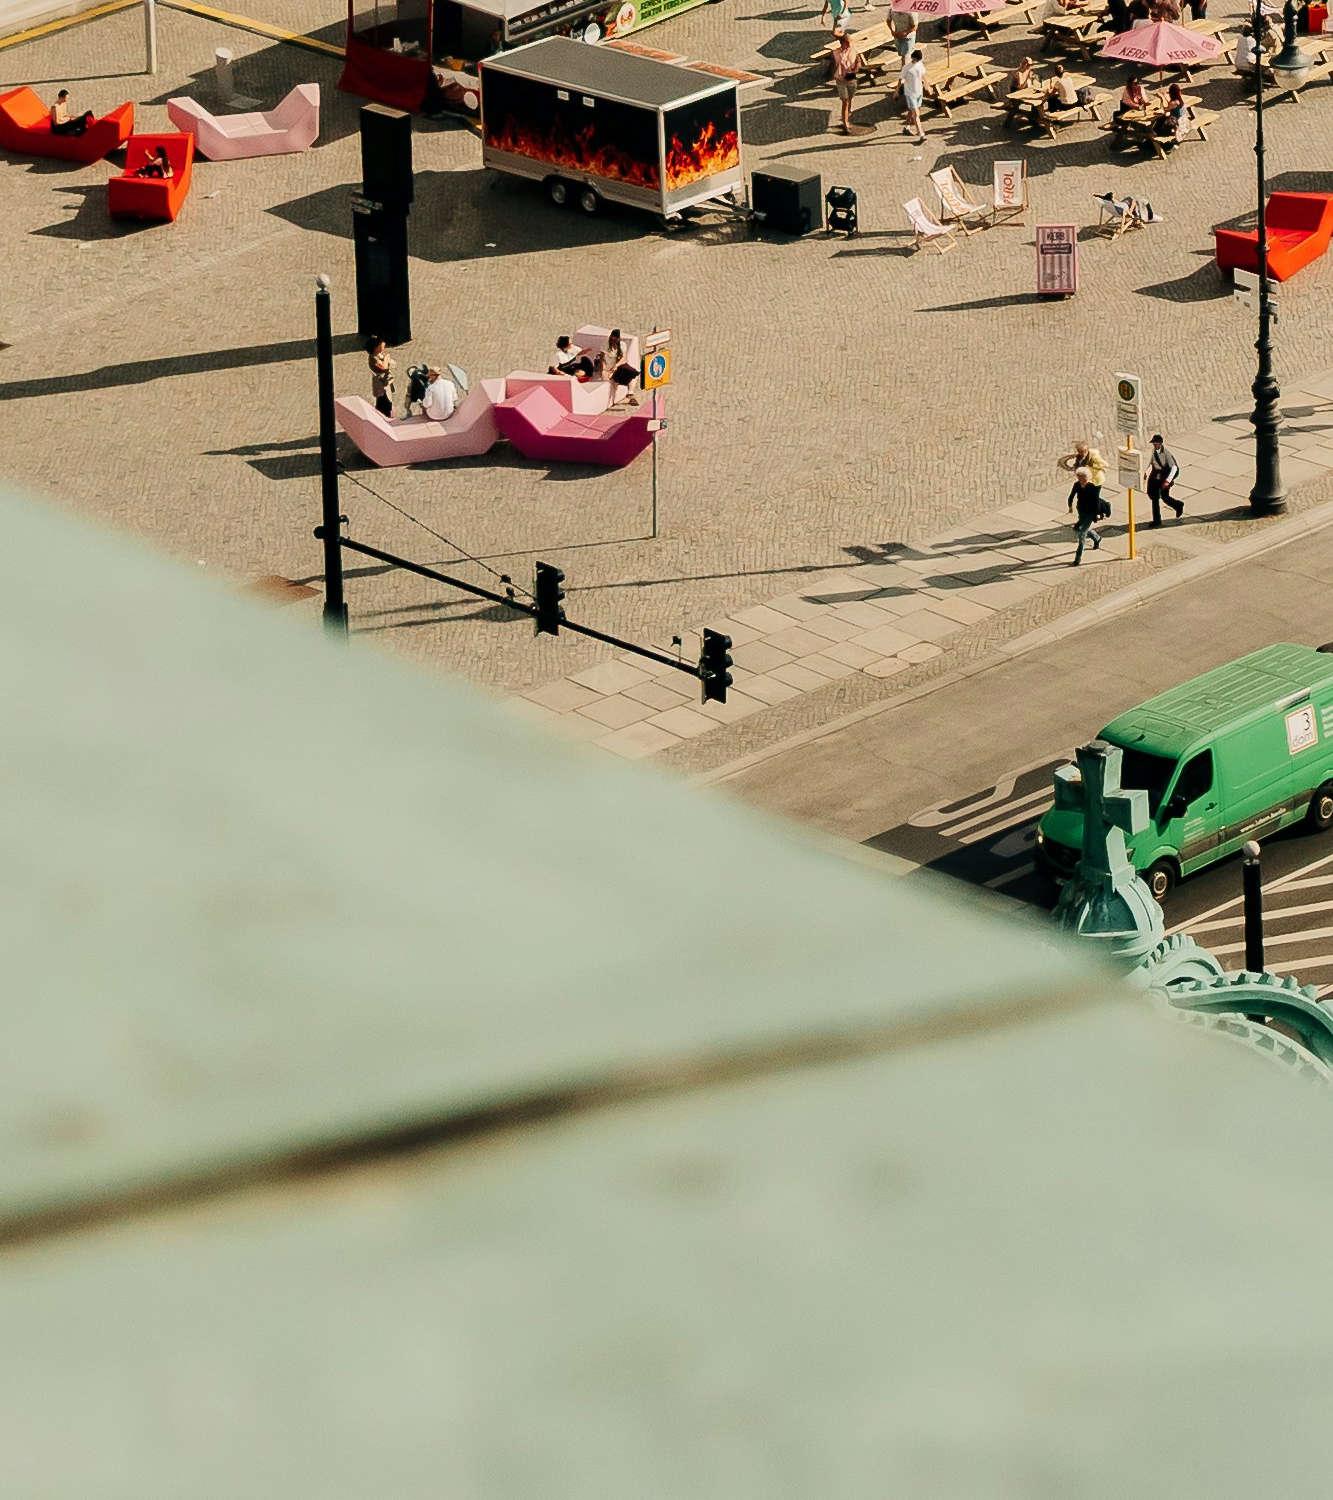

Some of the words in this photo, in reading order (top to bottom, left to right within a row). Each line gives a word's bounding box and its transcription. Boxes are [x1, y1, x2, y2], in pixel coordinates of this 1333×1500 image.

[910, 0, 940, 12] KERB
[956, 0, 987, 12] KERB
[1118, 46, 1150, 60] KERB
[1166, 49, 1198, 61] KERB
[1302, 712, 1311, 731] 3
[1292, 730, 1314, 748] dom
